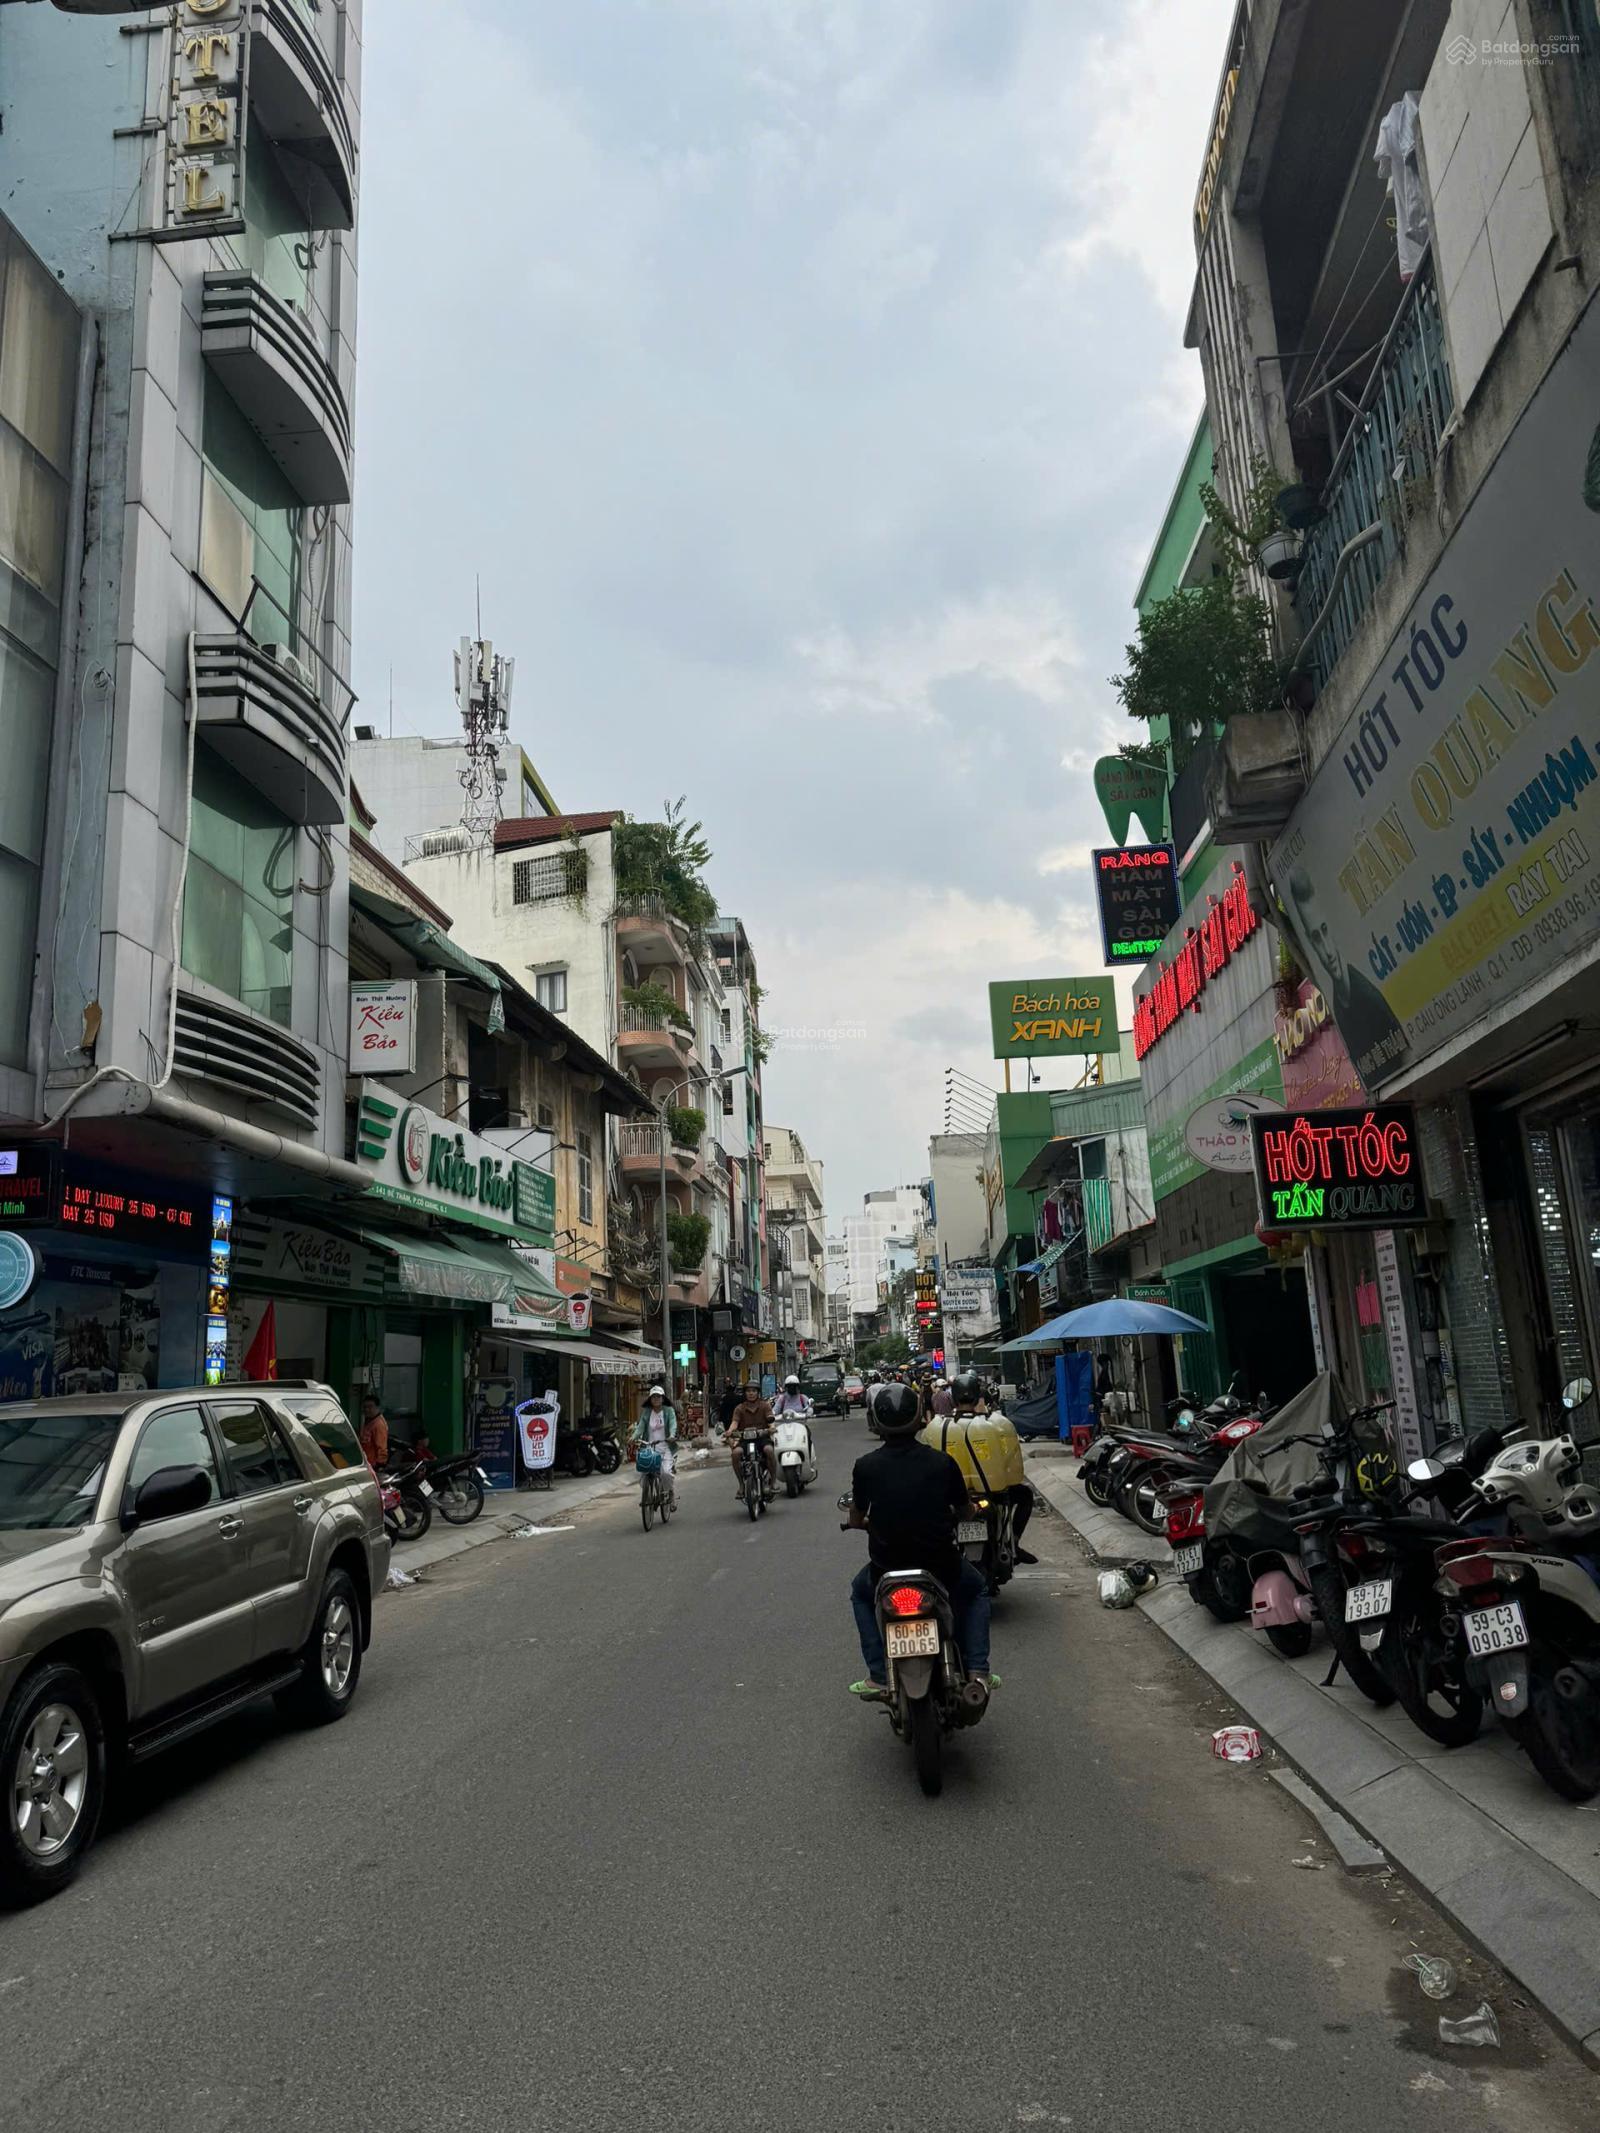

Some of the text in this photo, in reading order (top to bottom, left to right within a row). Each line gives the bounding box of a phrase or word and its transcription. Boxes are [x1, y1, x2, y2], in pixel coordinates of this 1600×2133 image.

[1343, 593, 1468, 799] HỚT TÓC
[1410, 567, 1600, 832] QUANG
[1100, 850, 1170, 870] RĂNG
[1368, 930, 1397, 980] CẮT
[1432, 874, 1458, 919] ÉP
[1506, 735, 1598, 845] NHUỘM
[1111, 868, 1163, 885] HÀM
[1506, 865, 1551, 918] RÁY
[1544, 827, 1590, 883] TAI
[1112, 886, 1166, 903] MẶT
[1123, 905, 1161, 922] SÀI
[1012, 990, 1101, 1014] Bách hóa
[357, 1004, 405, 1031] Kiều
[1008, 1017, 1102, 1042] XANH
[362, 1033, 399, 1050] Bảo
[1196, 1133, 1237, 1148] THẢO
[1264, 1117, 1333, 1183] HỚT
[1335, 1112, 1411, 1177] TÓC
[428, 1133, 478, 1198] Kiều
[478, 1156, 515, 1210] Bảo
[3, 1200, 25, 1216] Minh
[74, 1186, 91, 1205] DAY
[95, 1191, 125, 1212] LUXURY
[128, 1200, 139, 1214] 25
[141, 1201, 156, 1218] USD
[1272, 1182, 1417, 1220] TẤN QUANG
[63, 1204, 115, 1229] DAY 25 USD
[22, 1341, 45, 1361] VISA
[1353, 1584, 1385, 1604] 59-T2
[1349, 1597, 1388, 1620] 193.07
[1472, 1606, 1514, 1632] 59-C3
[895, 1622, 930, 1640] 60-B6
[1472, 1624, 1525, 1654] 090.38
[891, 1637, 936, 1656] 300.65
